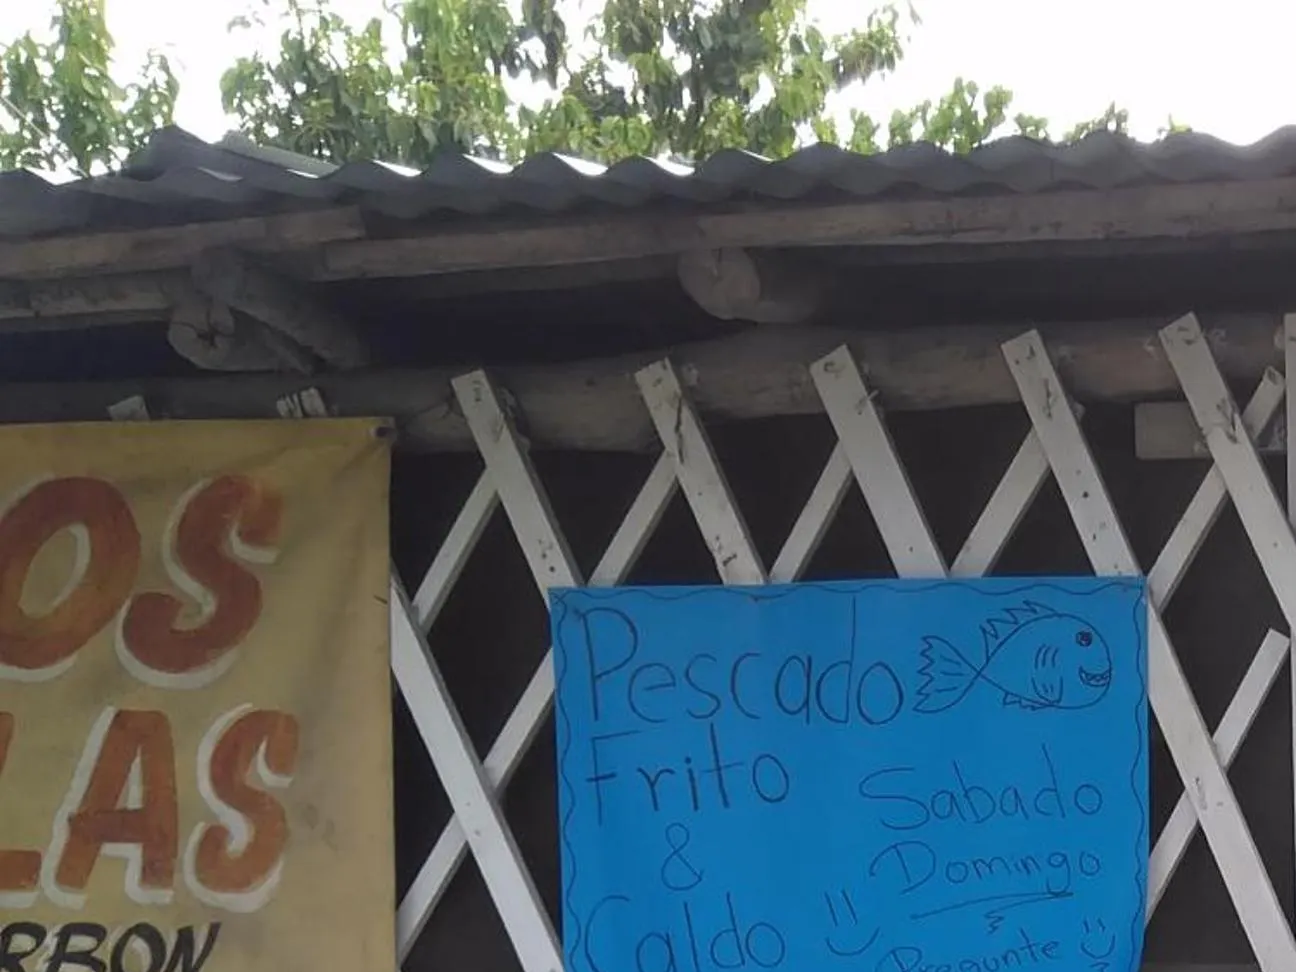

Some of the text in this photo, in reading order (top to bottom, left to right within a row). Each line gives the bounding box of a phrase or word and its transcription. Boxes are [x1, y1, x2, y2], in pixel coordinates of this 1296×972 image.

[576, 596, 905, 726] Pescado
[585, 723, 791, 826] Frito
[858, 744, 1104, 831] Sabado
[660, 822, 704, 892] &
[868, 840, 1102, 897] Domingo
